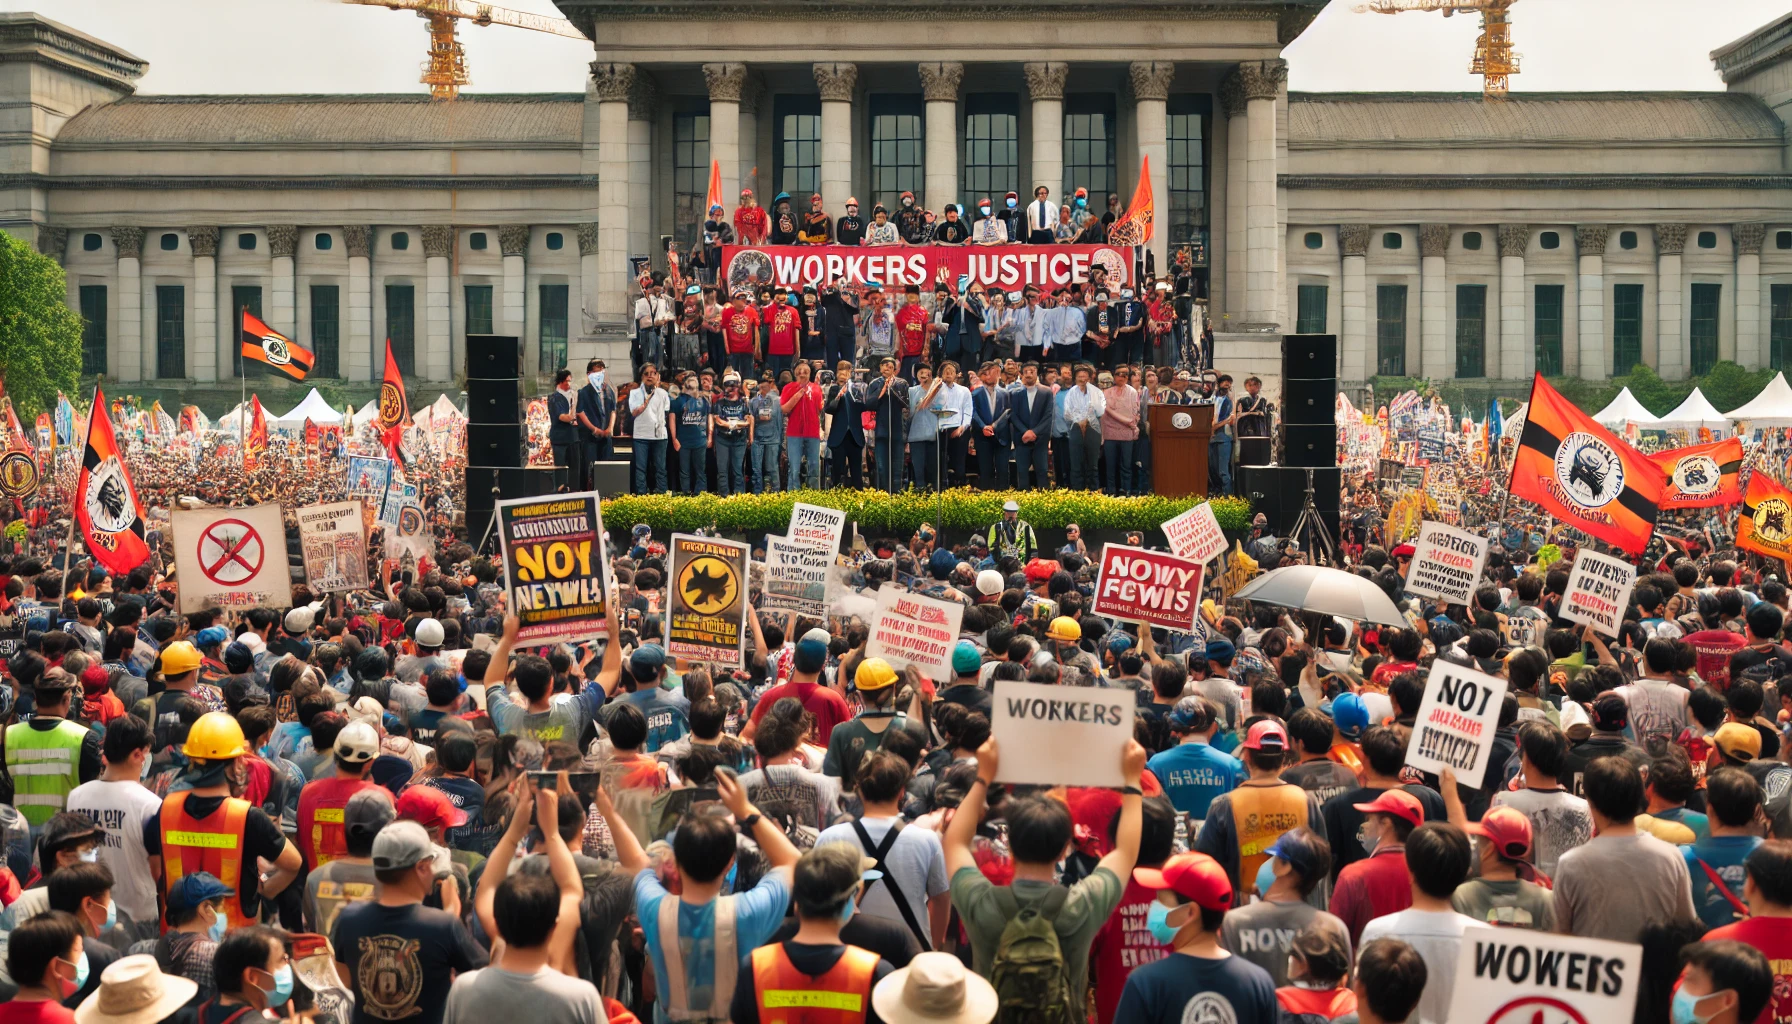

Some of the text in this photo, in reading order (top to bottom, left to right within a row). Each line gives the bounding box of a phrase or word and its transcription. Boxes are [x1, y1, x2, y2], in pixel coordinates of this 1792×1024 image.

[775, 253, 1089, 285] WORKERS JUSTICE
[1007, 697, 1123, 726] WORKERS
